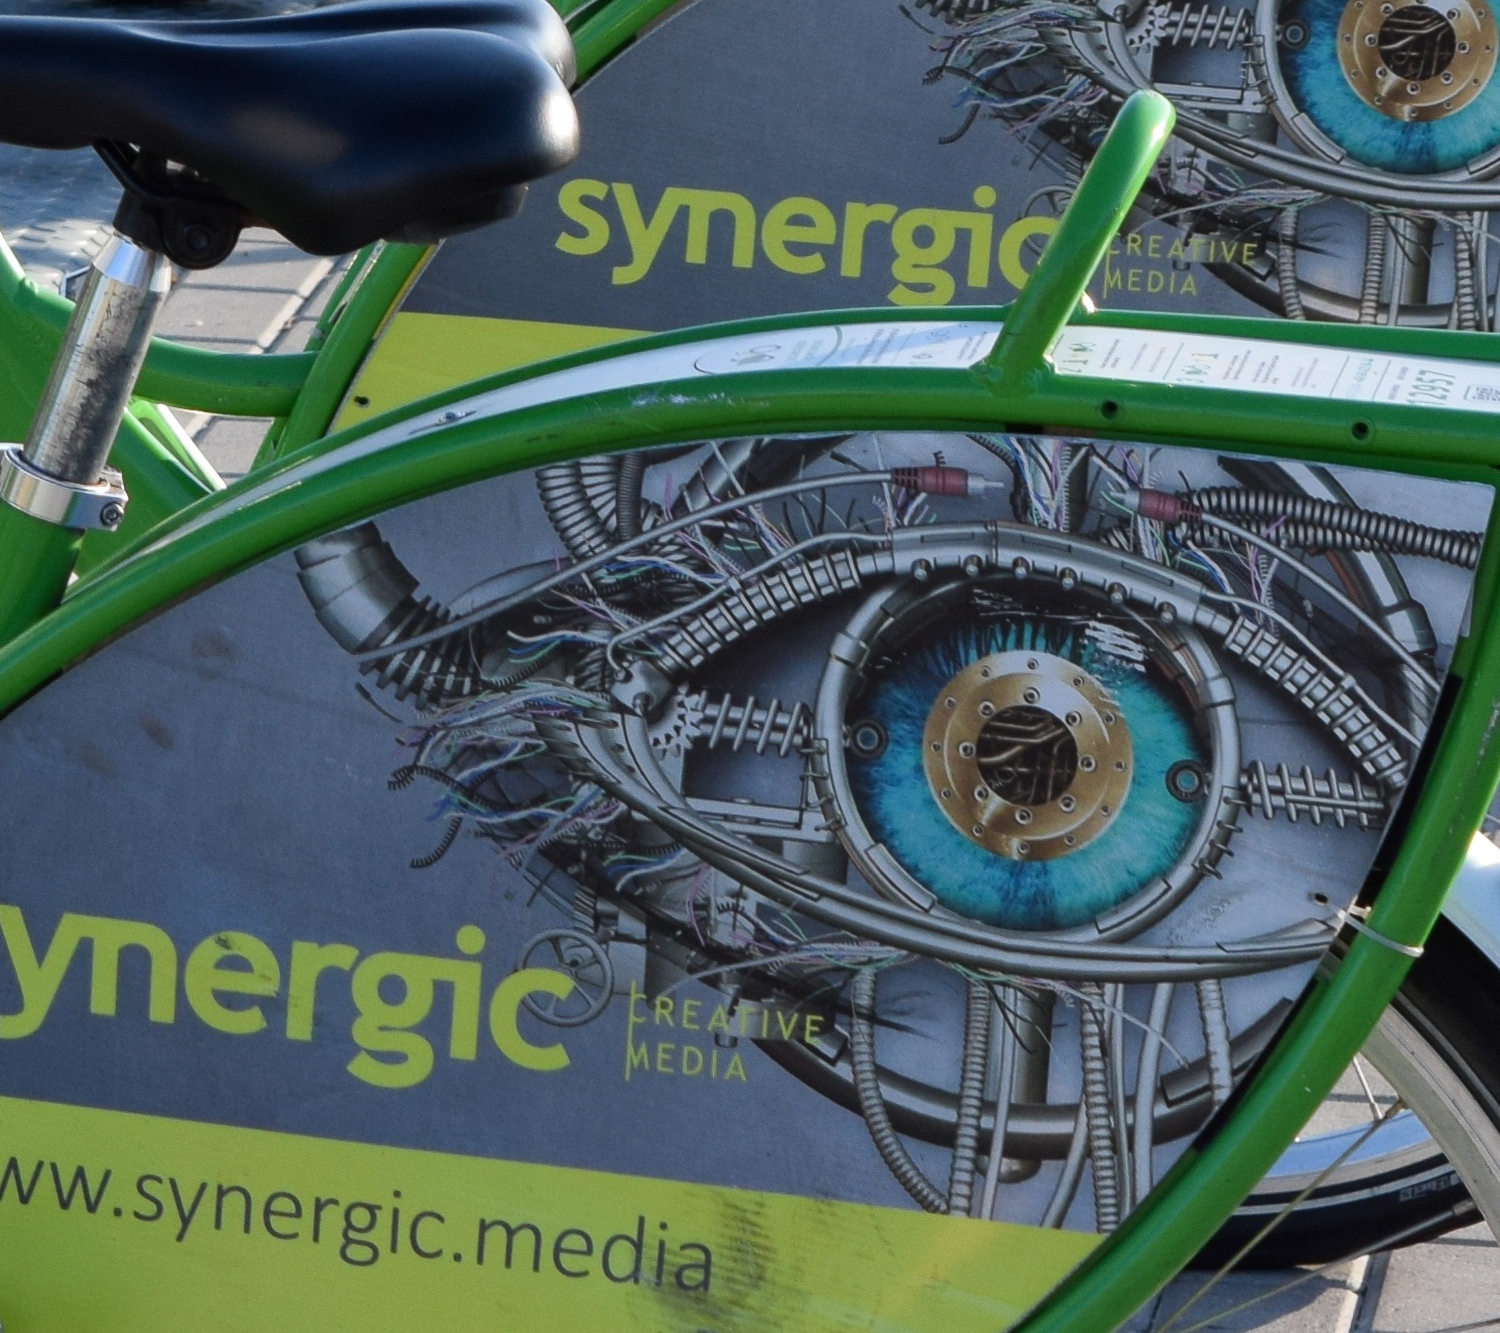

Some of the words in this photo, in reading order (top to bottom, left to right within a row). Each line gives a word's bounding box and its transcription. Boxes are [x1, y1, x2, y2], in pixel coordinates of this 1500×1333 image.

[553, 177, 1062, 306] synergic
[1103, 266, 1199, 297] MEDIA
[630, 990, 825, 1044] CREATIVE
[626, 1039, 747, 1082] MEDIA
